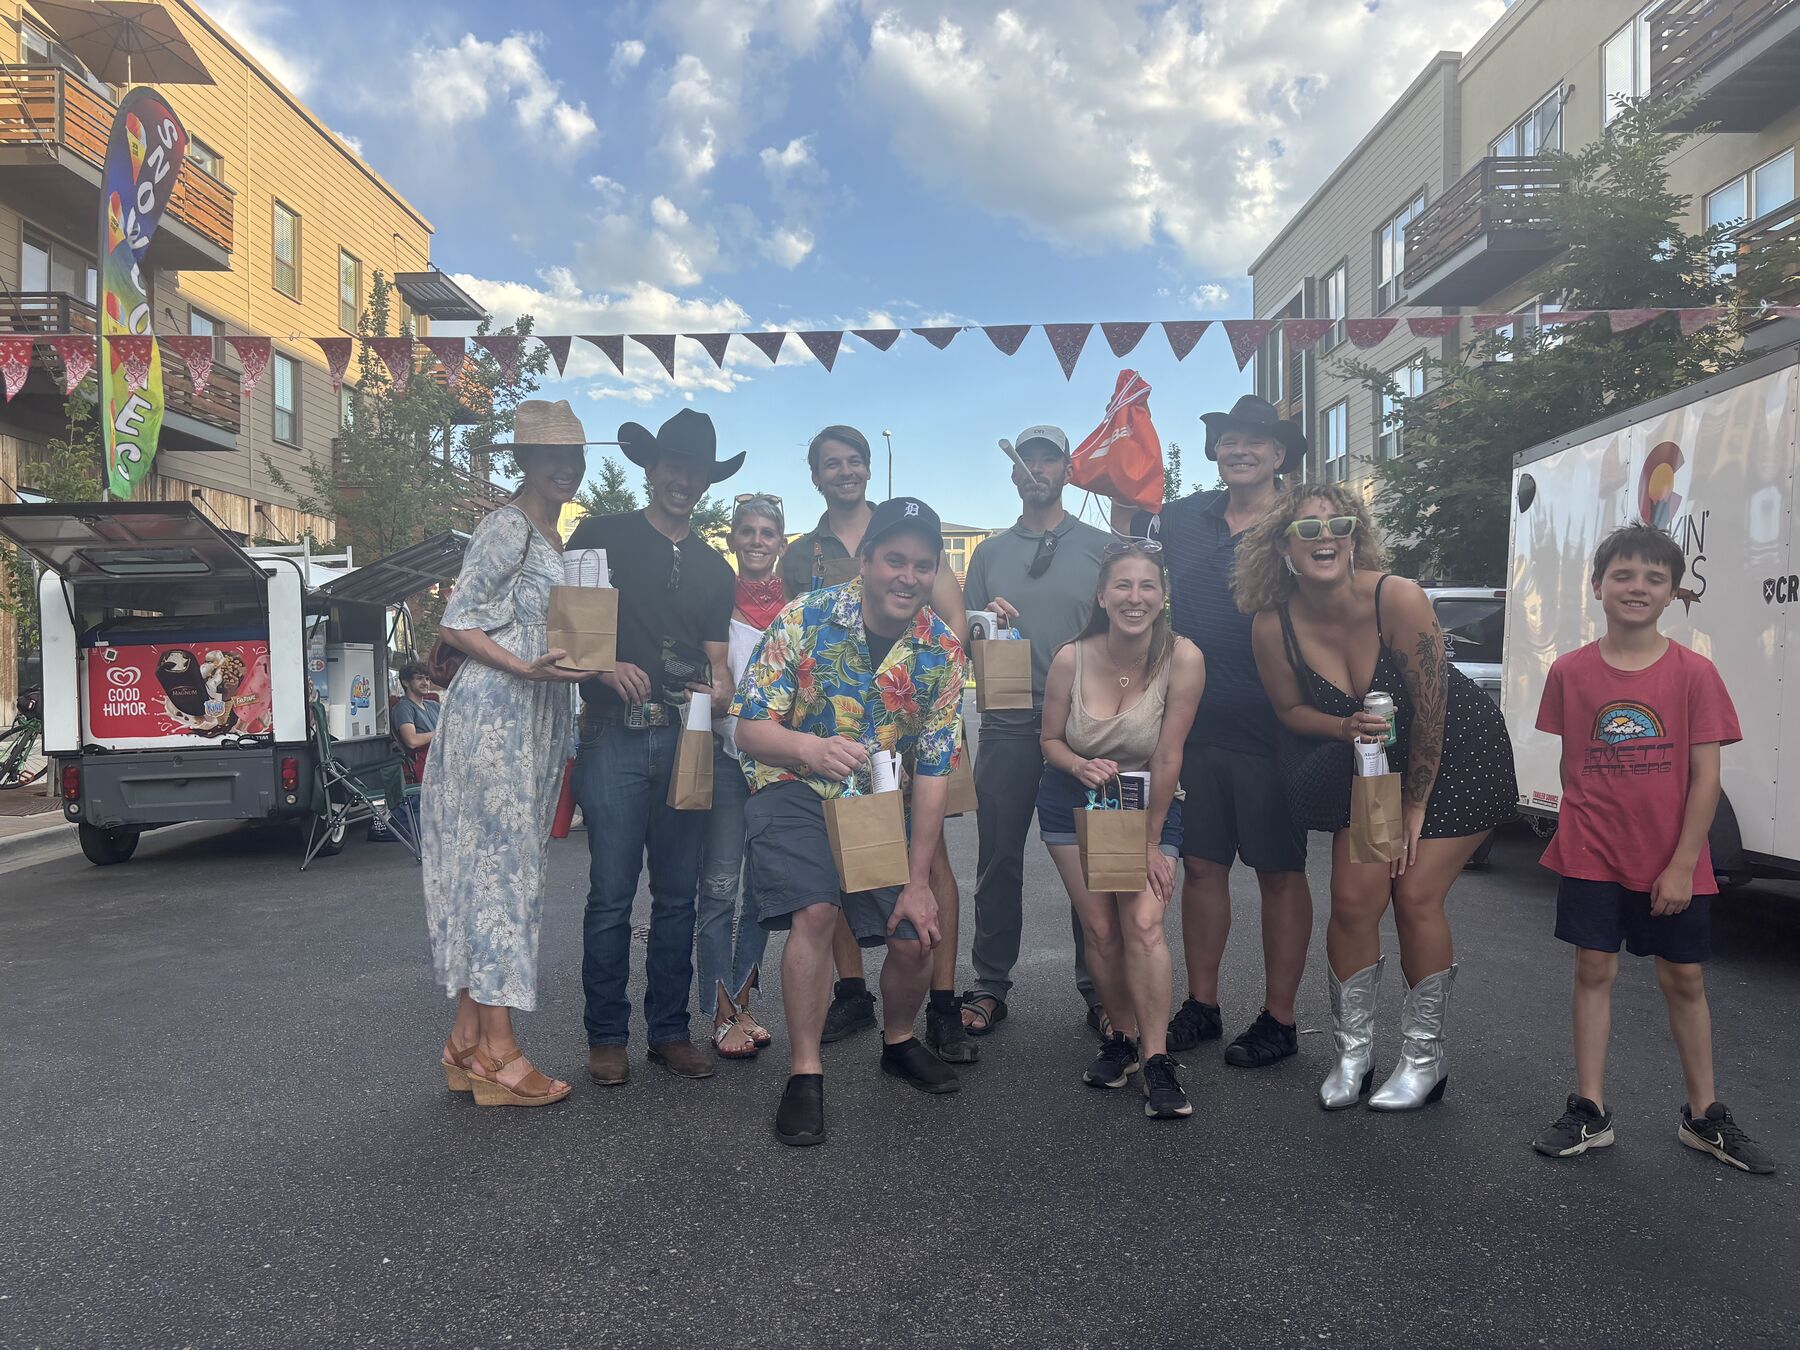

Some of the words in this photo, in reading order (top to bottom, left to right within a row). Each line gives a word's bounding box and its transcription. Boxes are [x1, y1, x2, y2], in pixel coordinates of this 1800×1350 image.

[108, 688, 140, 702] GOOD
[103, 702, 147, 717] HUMOR
[1589, 743, 1674, 762] AVETT
[1581, 762, 1672, 776] BROTHERS
